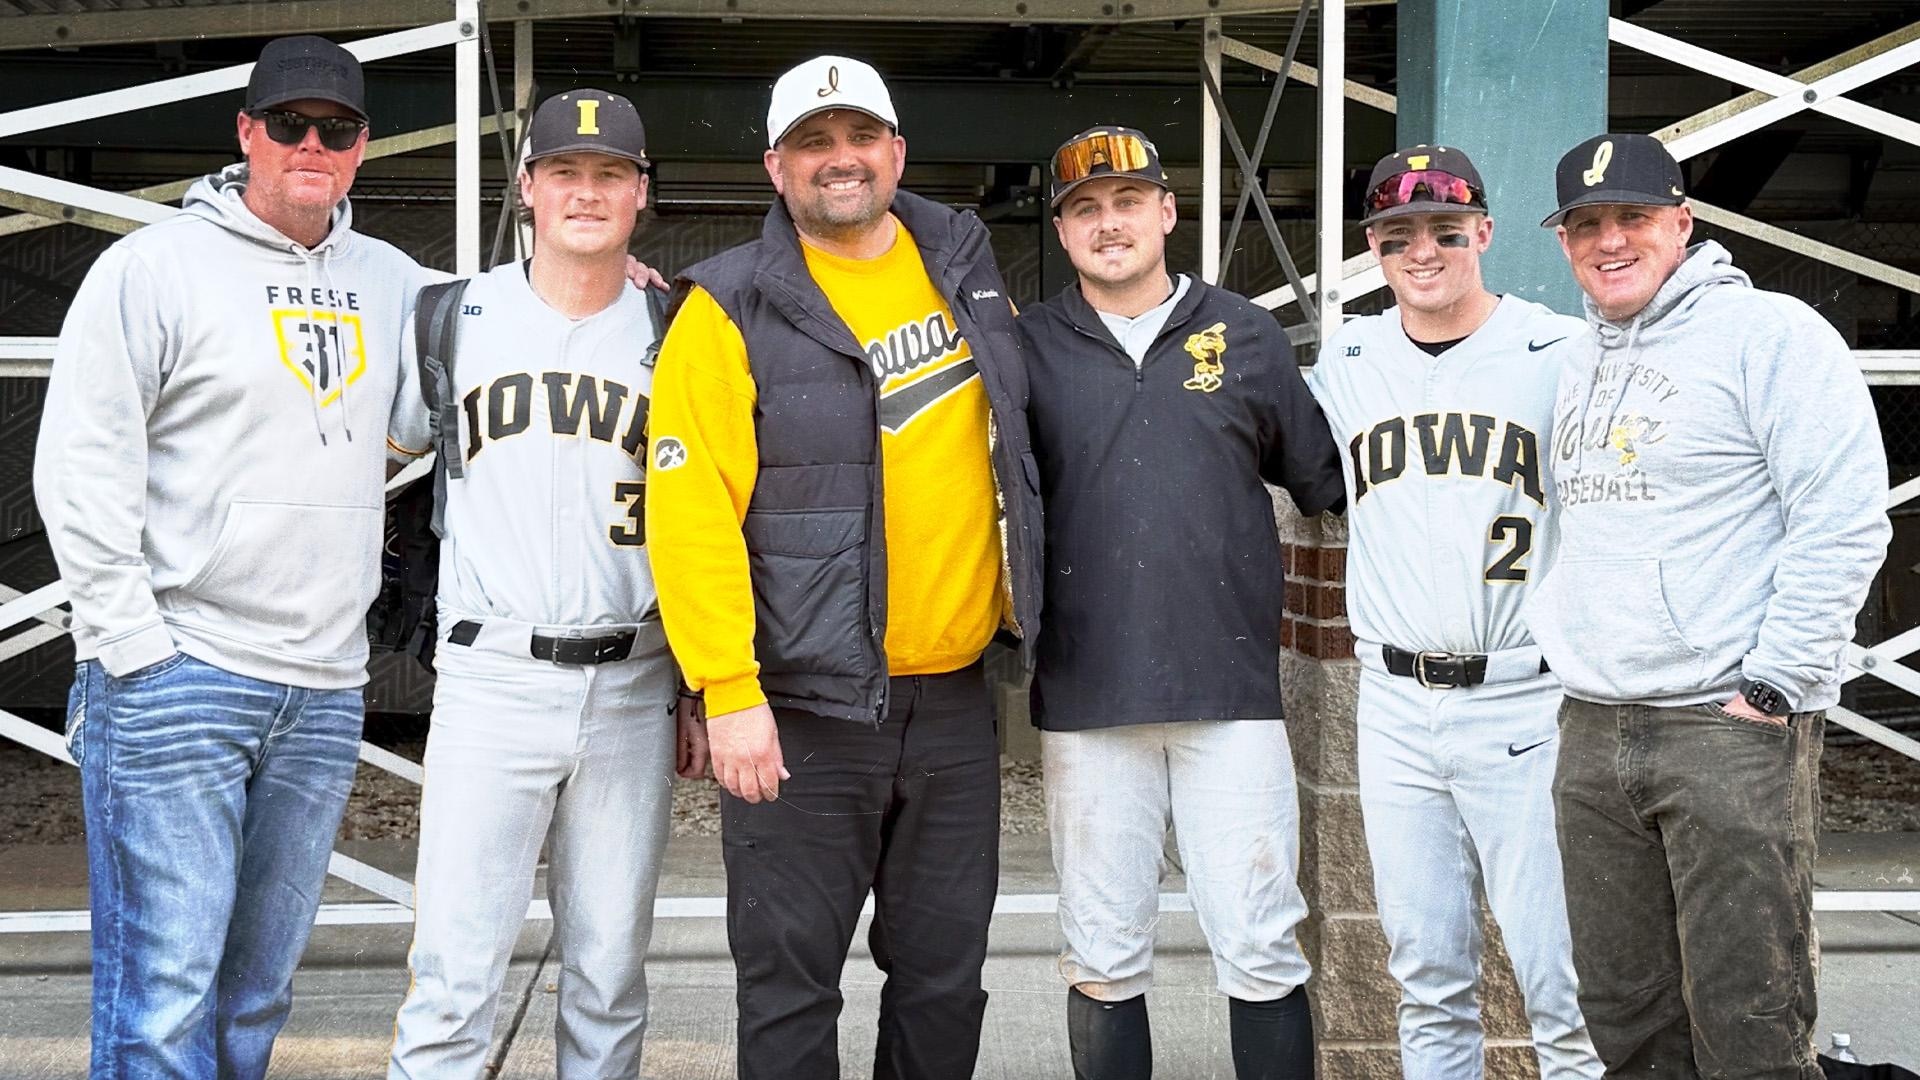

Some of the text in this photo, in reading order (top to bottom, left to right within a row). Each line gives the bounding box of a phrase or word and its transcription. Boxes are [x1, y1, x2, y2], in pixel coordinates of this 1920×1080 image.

[577, 99, 600, 135] I
[266, 285, 360, 311] FRESE
[866, 311, 961, 386] owa
[1592, 361, 1679, 403] NIVERSITY
[1349, 412, 1547, 507] IOWA
[609, 480, 647, 548] 3
[1557, 471, 1656, 507] ASEBALL
[1485, 514, 1534, 582] 2
